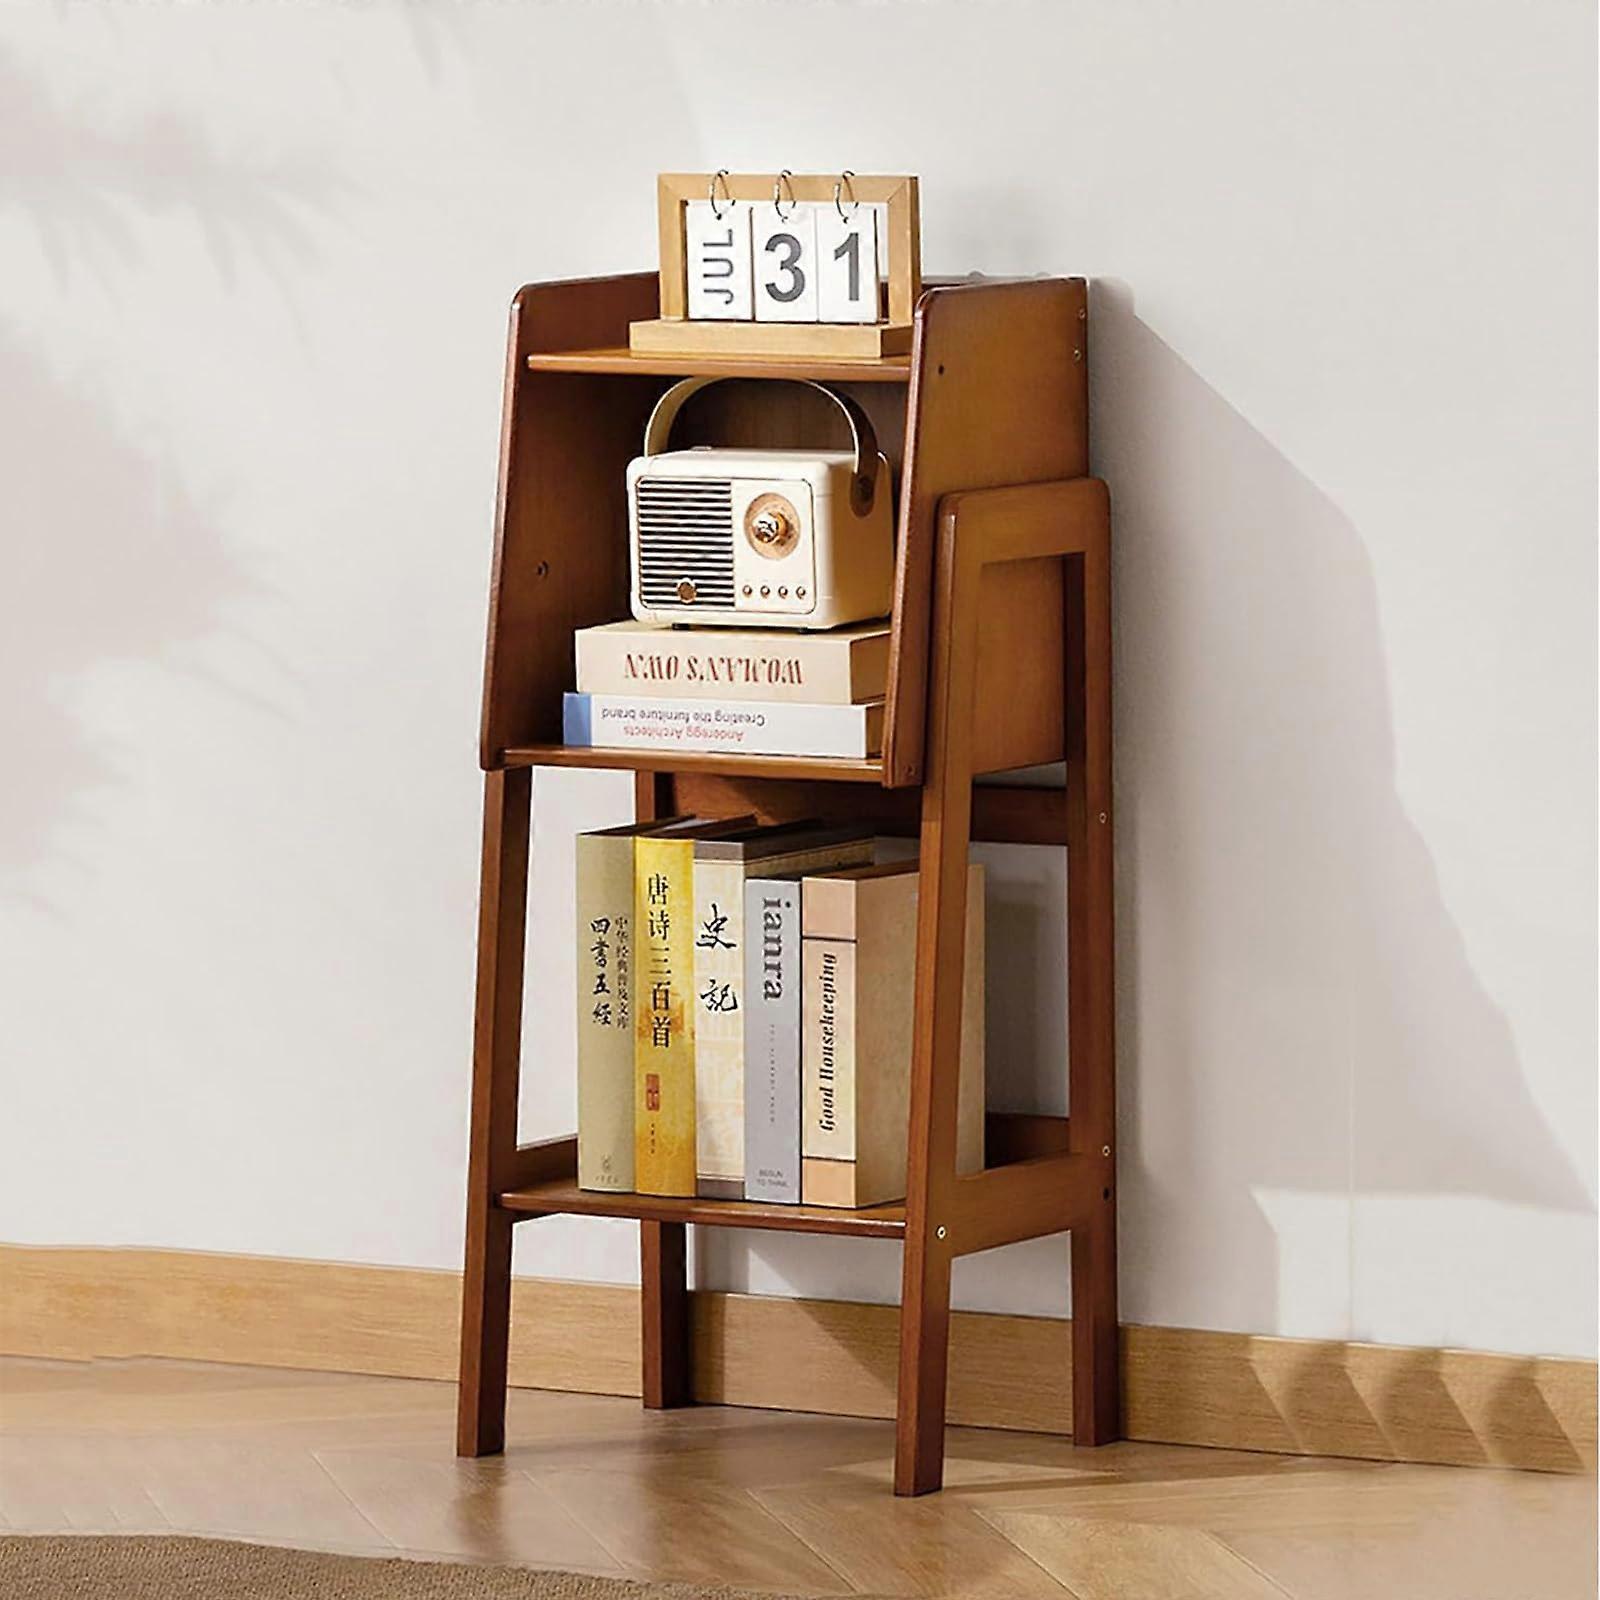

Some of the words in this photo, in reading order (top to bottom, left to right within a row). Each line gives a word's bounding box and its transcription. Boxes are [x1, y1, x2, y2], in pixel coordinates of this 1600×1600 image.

[702, 228, 734, 305] JUL
[623, 653, 679, 681] OWN
[686, 655, 803, 685] WOMAN'S
[601, 707, 636, 721] brand
[639, 710, 691, 723] furniture
[694, 711, 712, 724] the
[715, 709, 766, 727] Creating
[623, 726, 683, 740] Architects
[647, 873, 672, 1048] 唐诗三百首
[818, 953, 837, 1081] Housekeeping
[818, 1086, 836, 1132] Good
